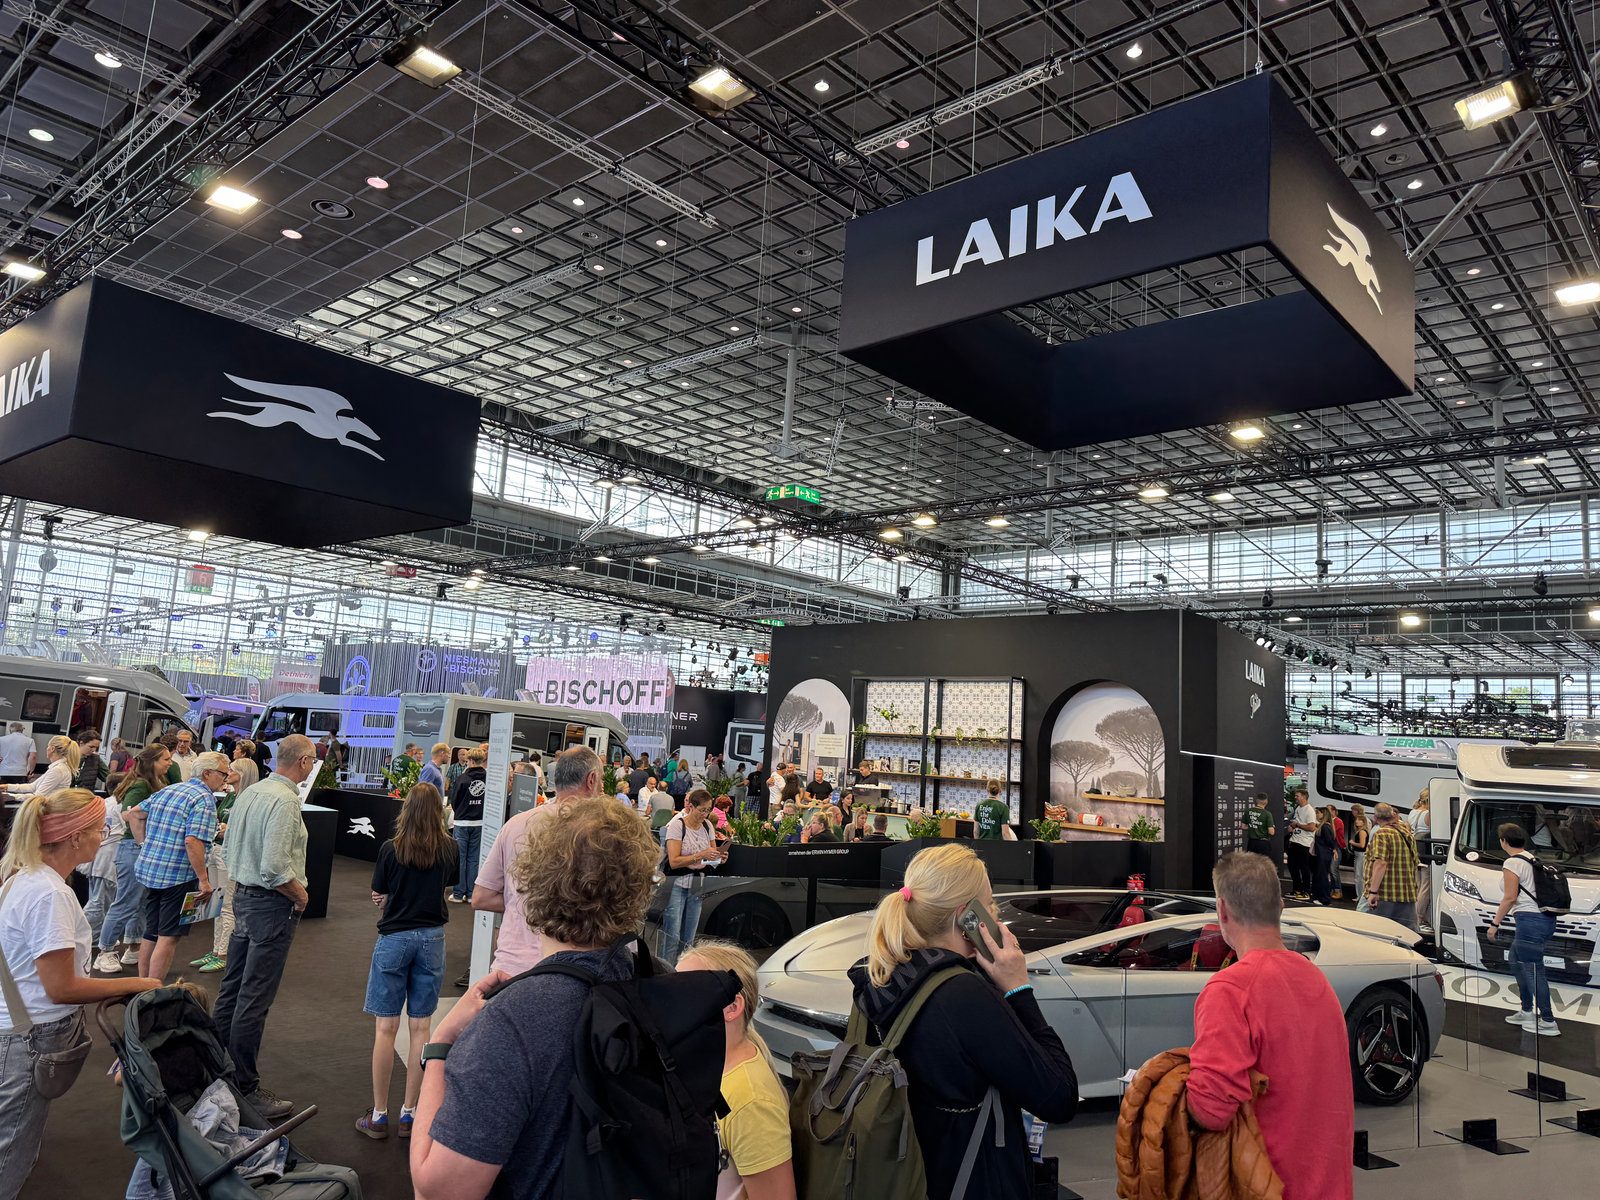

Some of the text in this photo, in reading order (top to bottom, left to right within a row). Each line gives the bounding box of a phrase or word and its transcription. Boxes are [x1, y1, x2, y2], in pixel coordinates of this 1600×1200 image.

[916, 171, 1153, 286] LAIKA
[0, 349, 50, 418] IKA
[444, 654, 500, 668] NIESMANN
[1245, 659, 1265, 688] LAIKA
[1395, 738, 1436, 748] ERIBA
